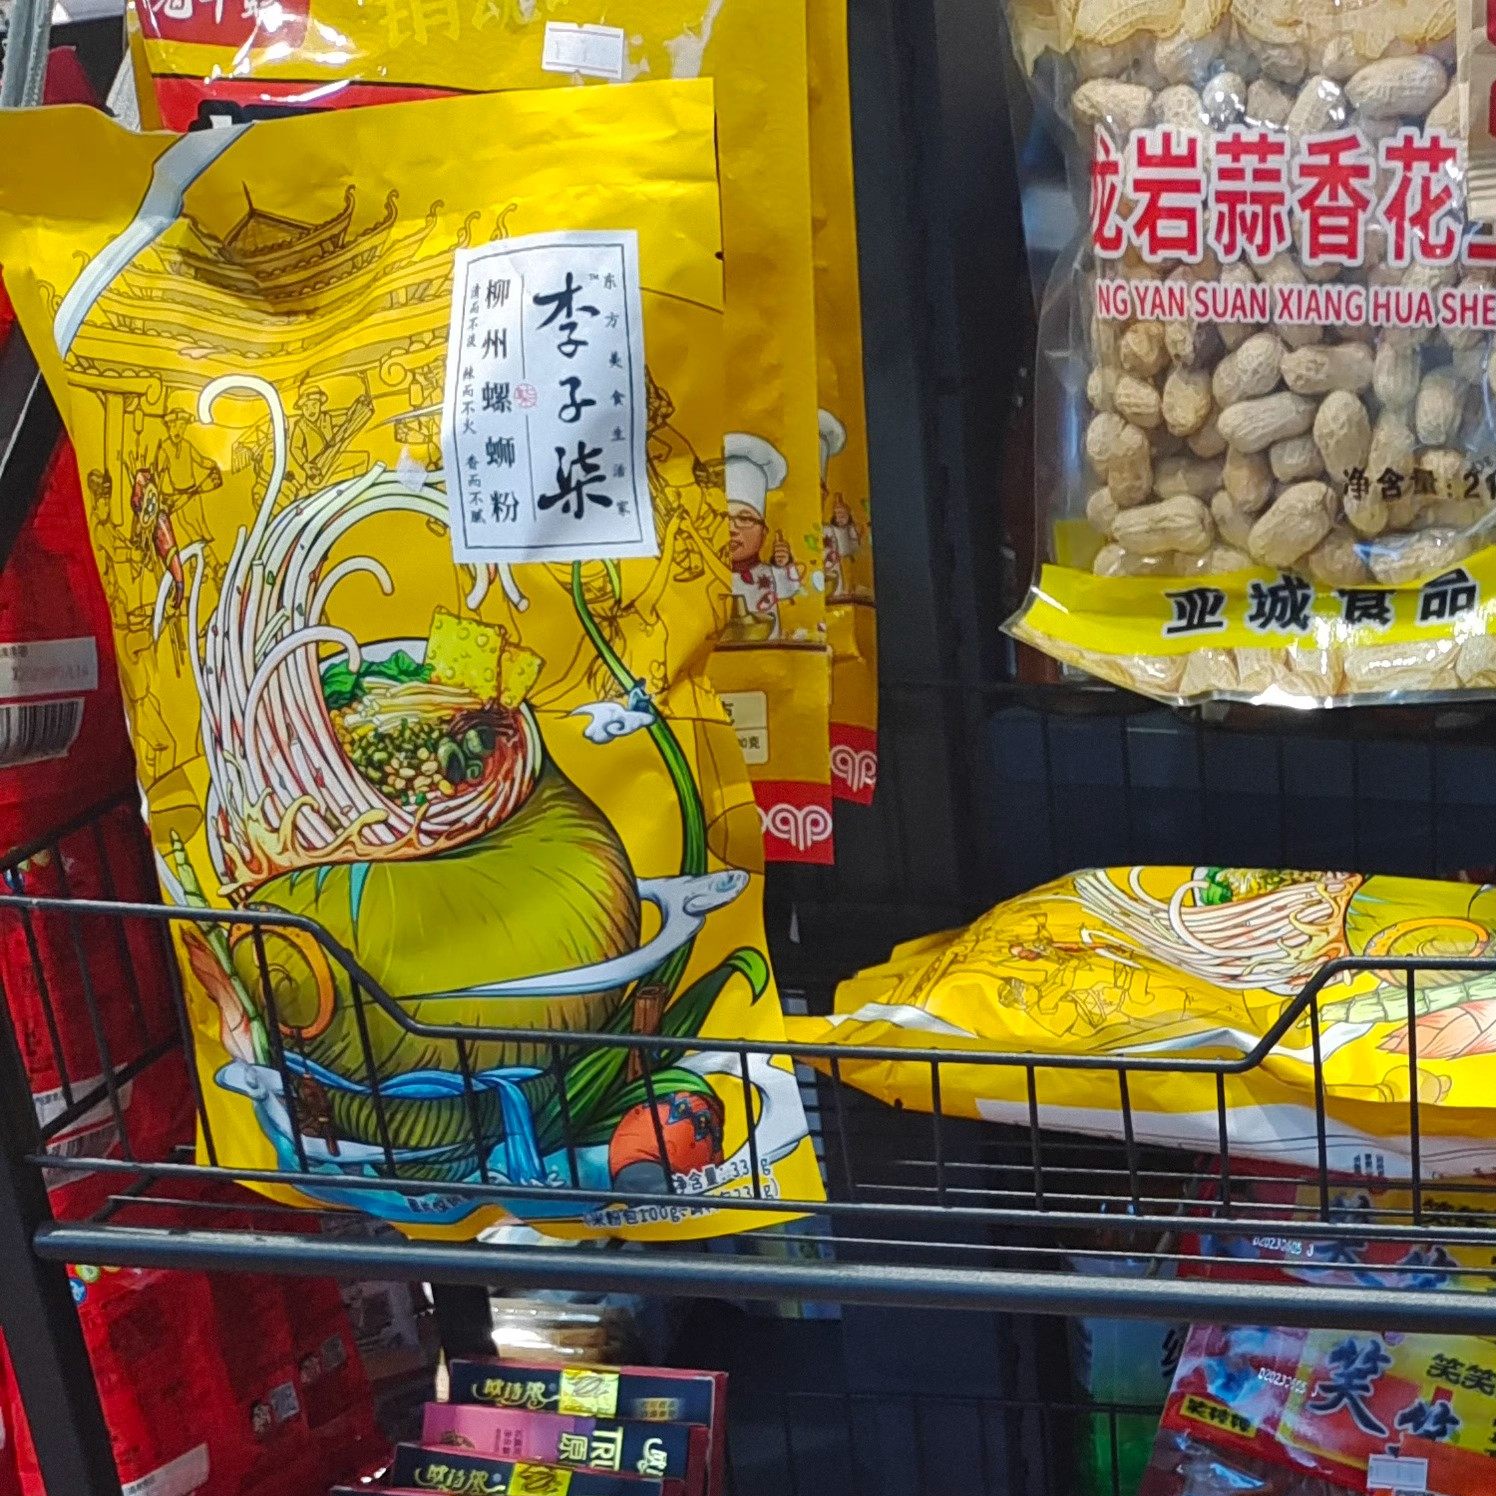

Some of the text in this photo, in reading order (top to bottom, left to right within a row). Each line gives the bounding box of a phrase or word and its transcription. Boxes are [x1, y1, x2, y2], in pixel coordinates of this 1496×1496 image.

[481, 278, 520, 524] 柳州螺蛳粉
[532, 271, 613, 520] 李子柒
[603, 273, 632, 517] 东方美食生活家
[1136, 288, 1186, 318] YAN
[1193, 289, 1268, 320] SUAN
[1276, 291, 1364, 322] XIANG
[1373, 293, 1435, 325] HUA
